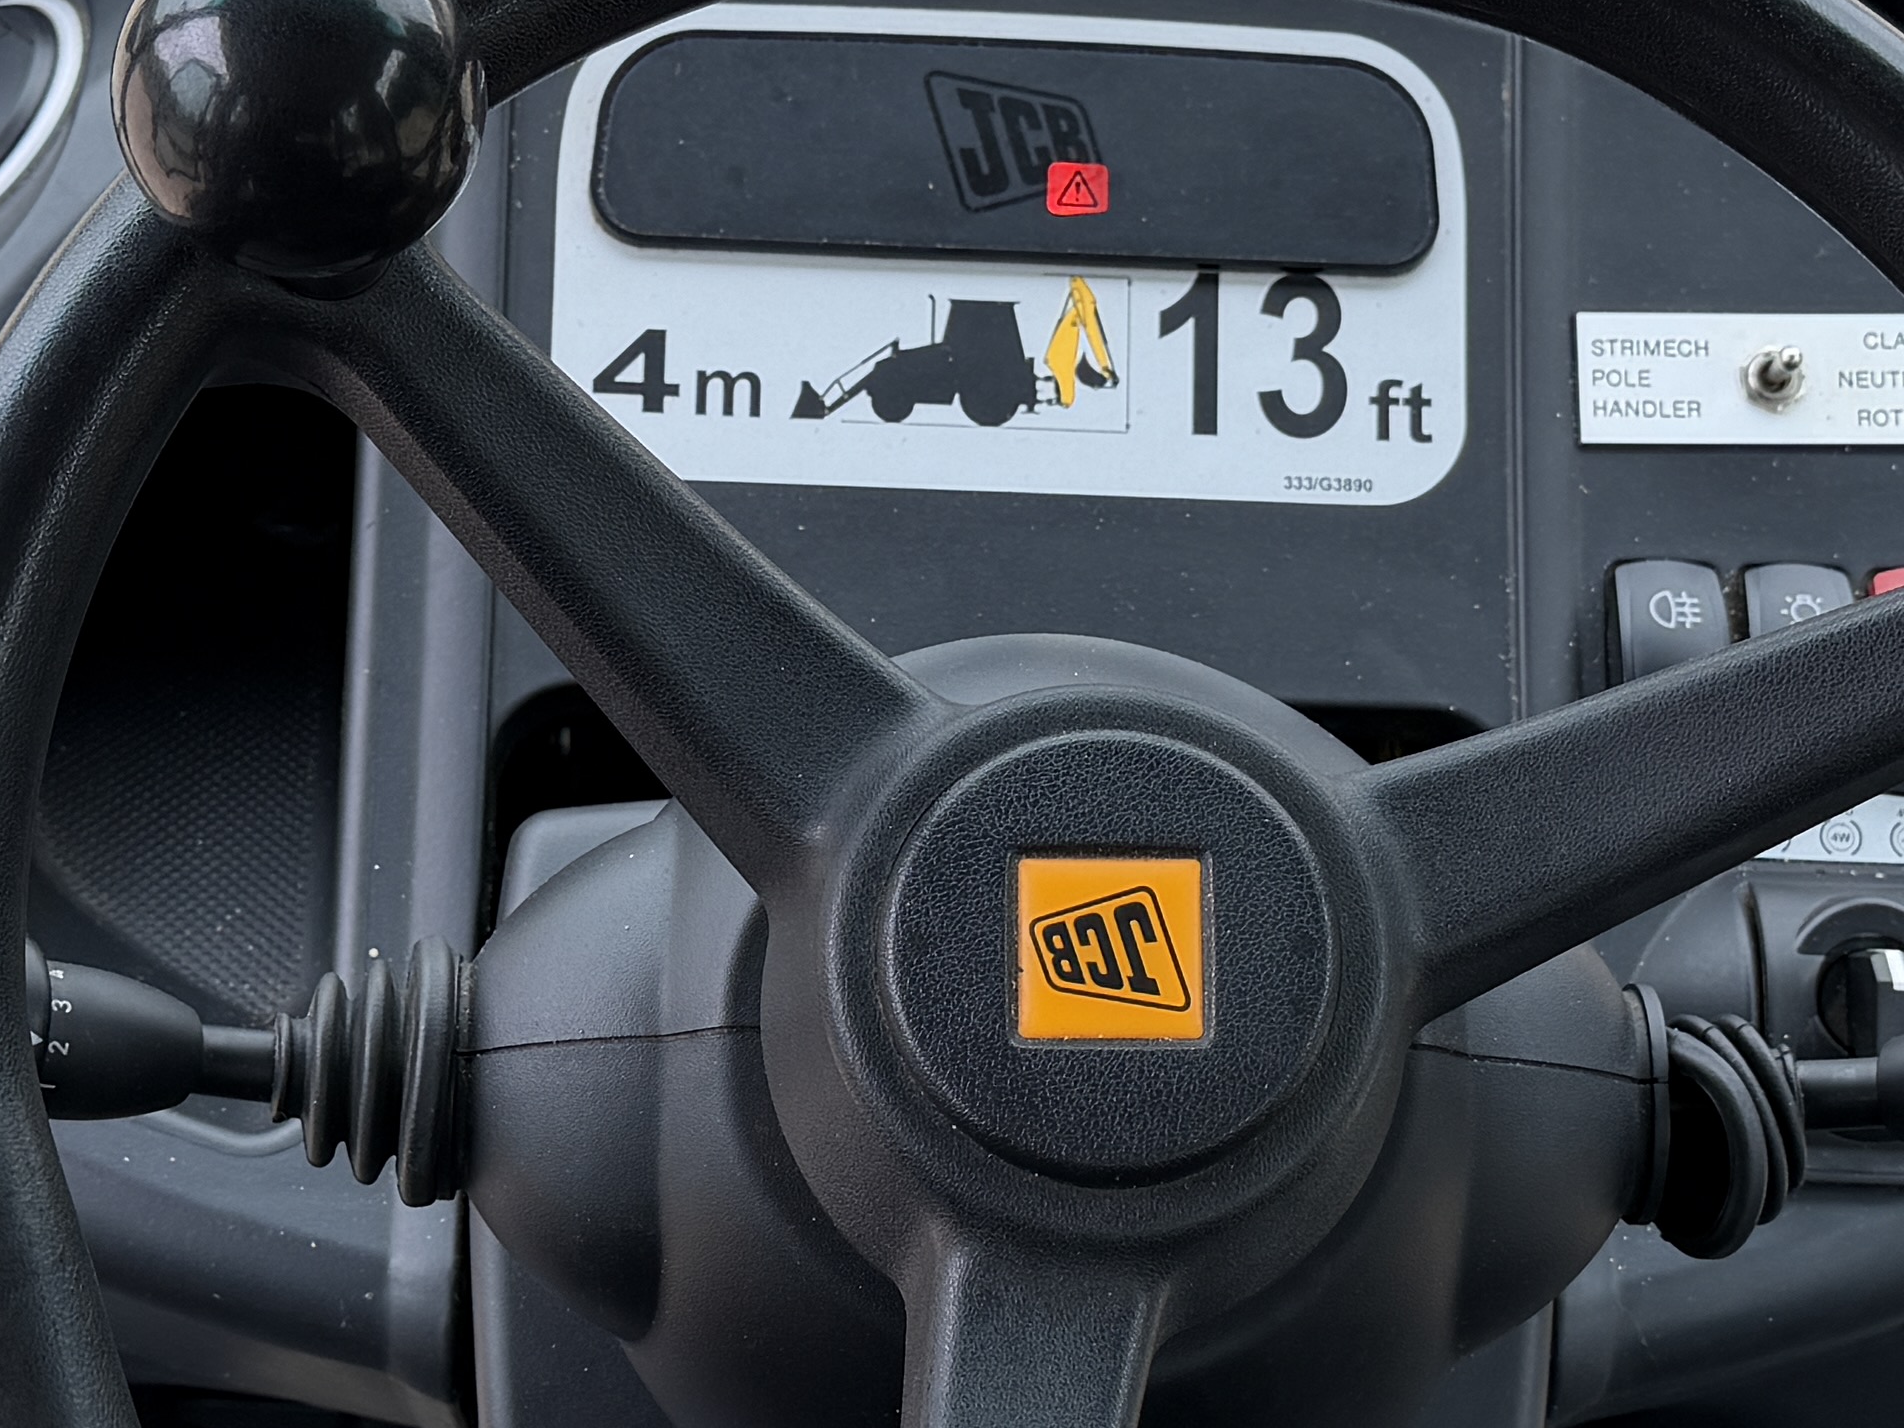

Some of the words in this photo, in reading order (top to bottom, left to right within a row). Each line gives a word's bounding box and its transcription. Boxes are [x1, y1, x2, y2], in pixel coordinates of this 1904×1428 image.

[957, 87, 1093, 197] JCB
[1590, 337, 1710, 359] STRIMECH
[1591, 368, 1652, 388] POLE
[1592, 398, 1702, 419] HANDLER
[1283, 475, 1374, 493] 333/G3890
[1042, 901, 1161, 996] JCB
[51, 998, 73, 1014] 3
[48, 1040, 70, 1056] 2
